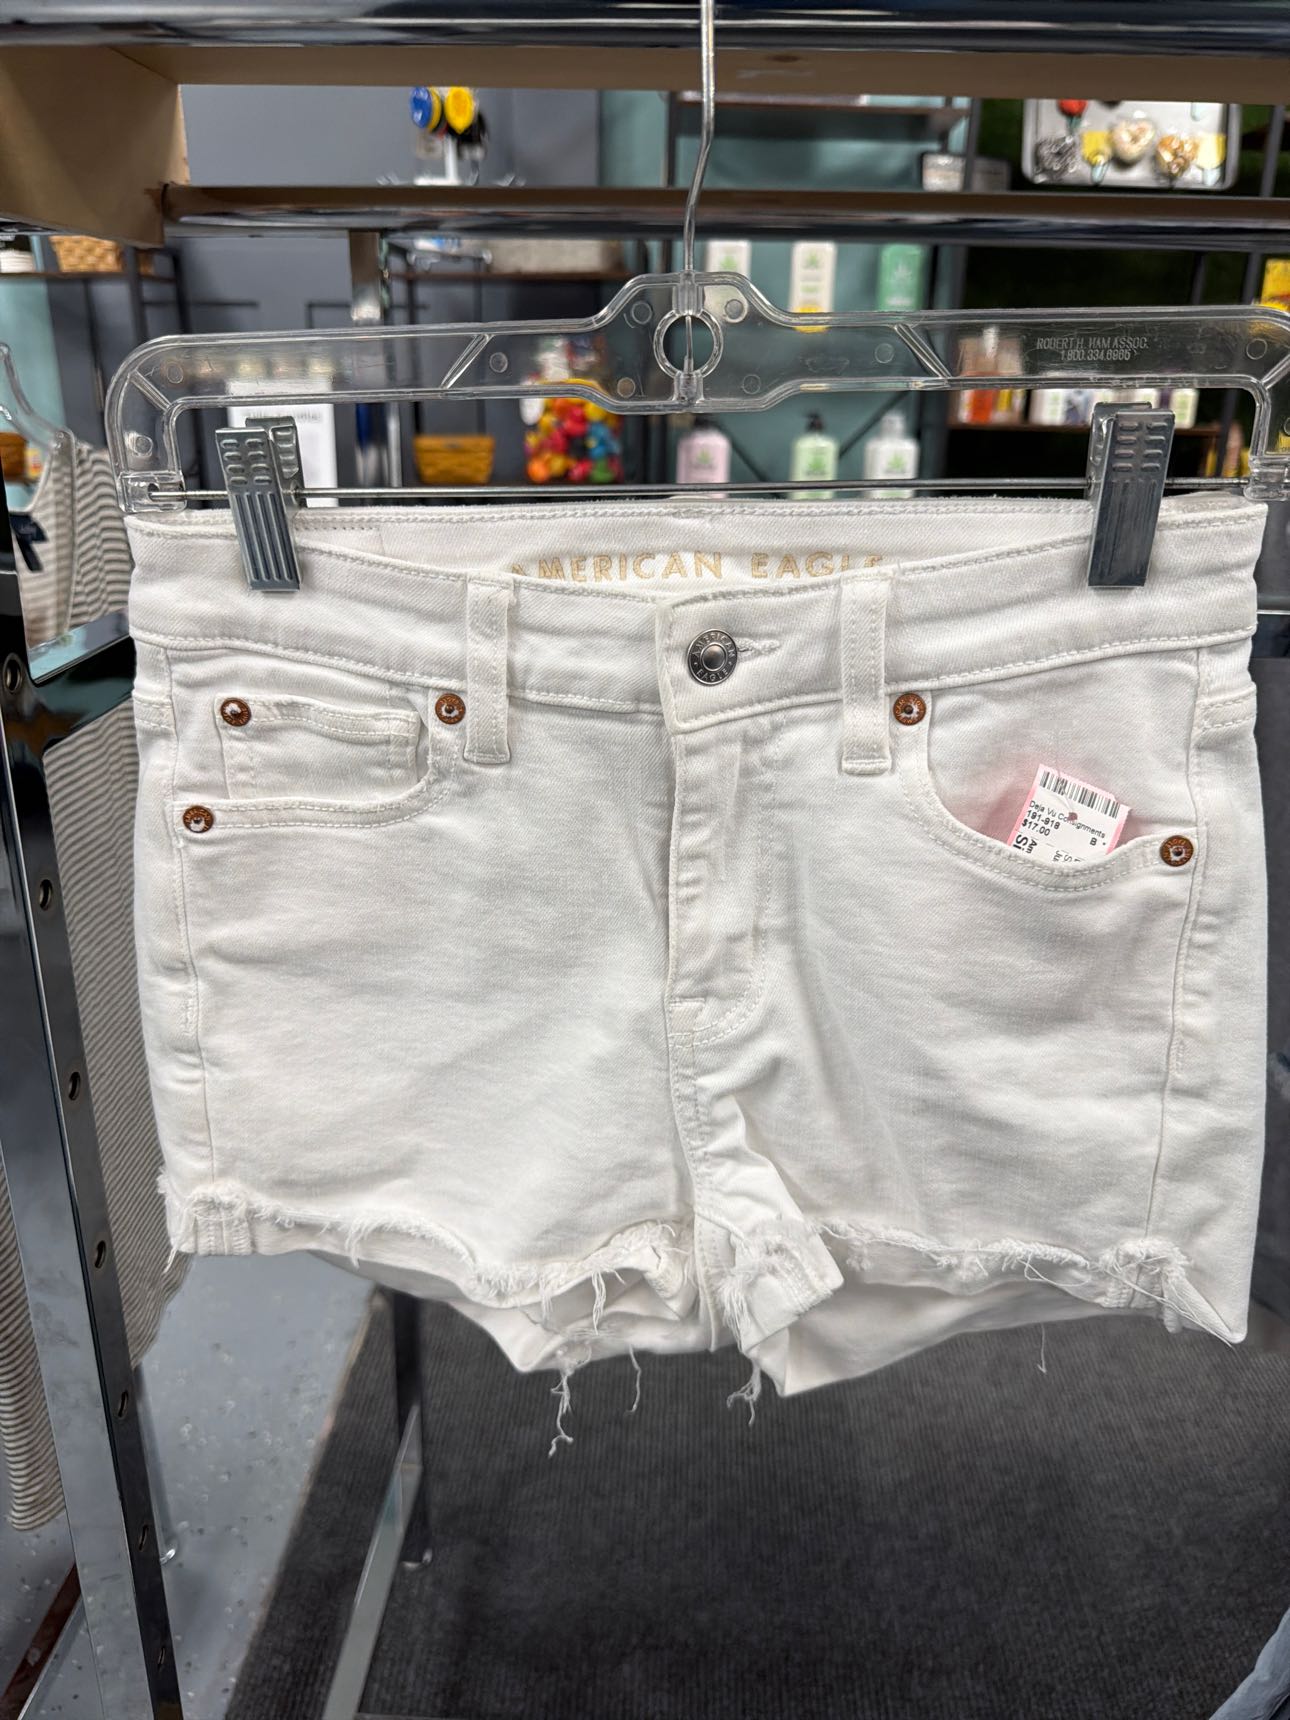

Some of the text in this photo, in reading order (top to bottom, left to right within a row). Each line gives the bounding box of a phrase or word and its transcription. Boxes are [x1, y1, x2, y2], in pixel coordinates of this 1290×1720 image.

[696, 668, 729, 681] EAGLE
[1030, 800, 1045, 812] Deja
[1047, 808, 1057, 817] Vu
[1022, 818, 1051, 836] $17.00
